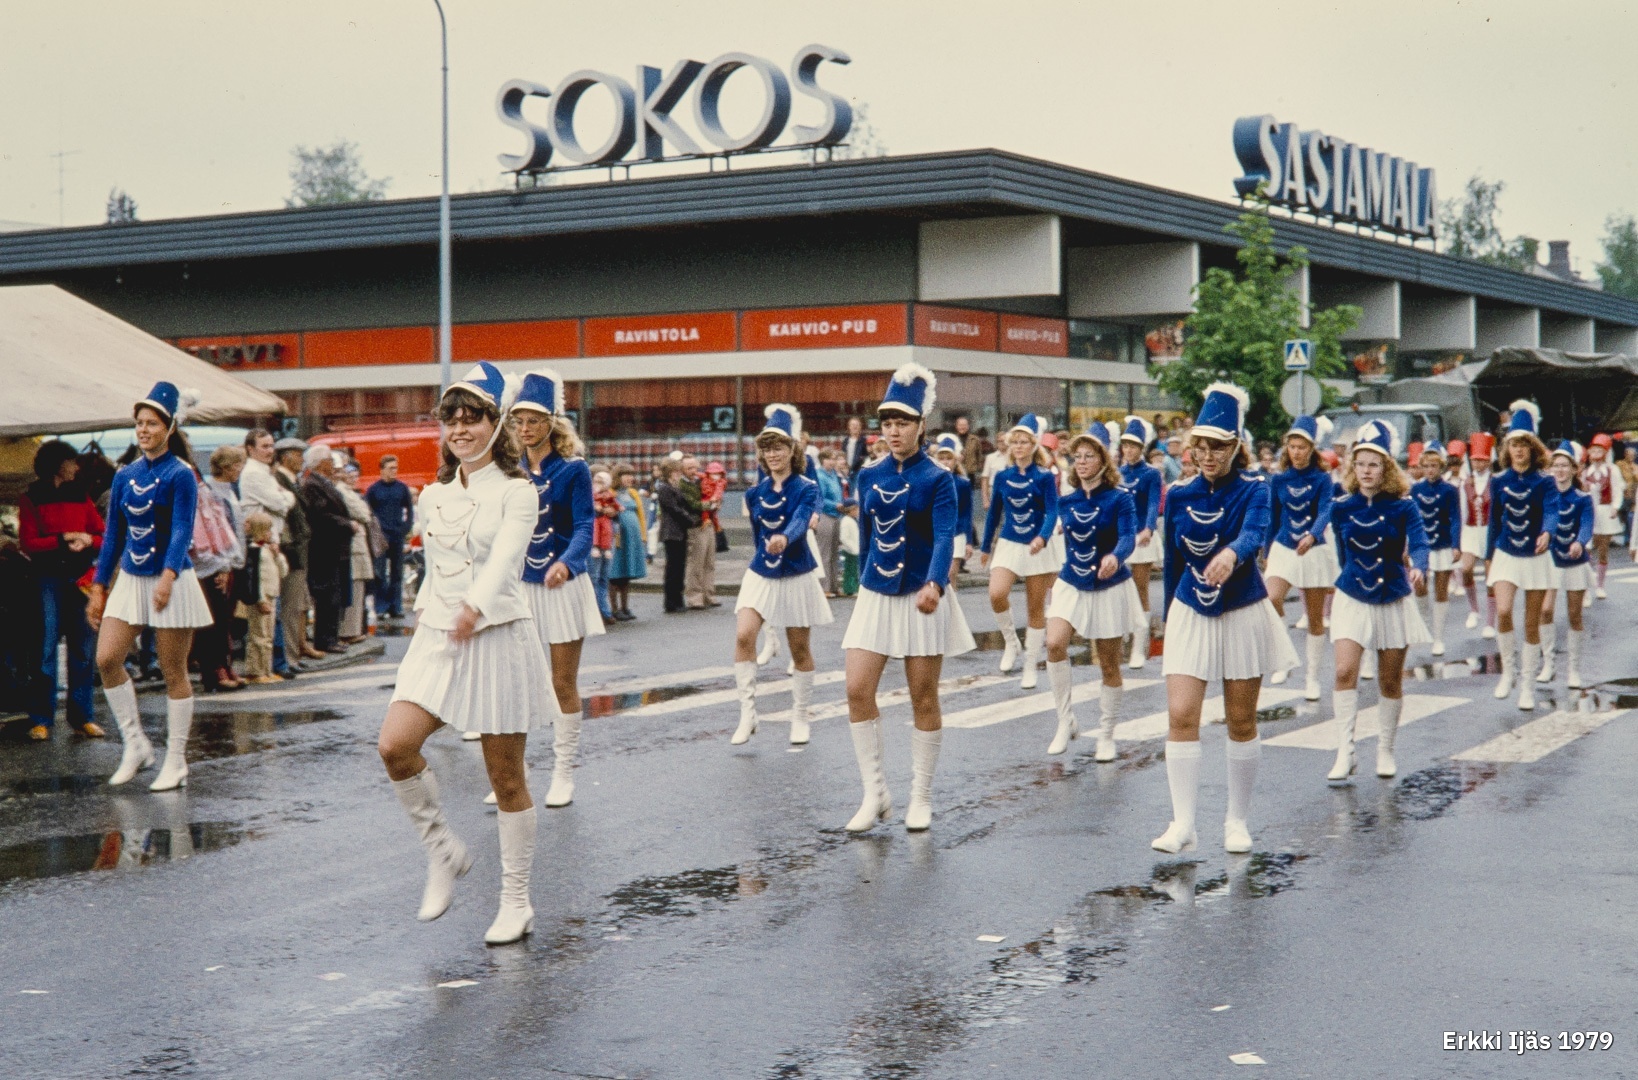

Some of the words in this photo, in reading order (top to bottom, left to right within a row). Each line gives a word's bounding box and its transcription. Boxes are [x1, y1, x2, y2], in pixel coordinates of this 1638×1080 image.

[495, 43, 852, 172] SOKOS
[1232, 114, 1437, 238] SASTAMALA
[614, 328, 699, 343] RAVINTOLA
